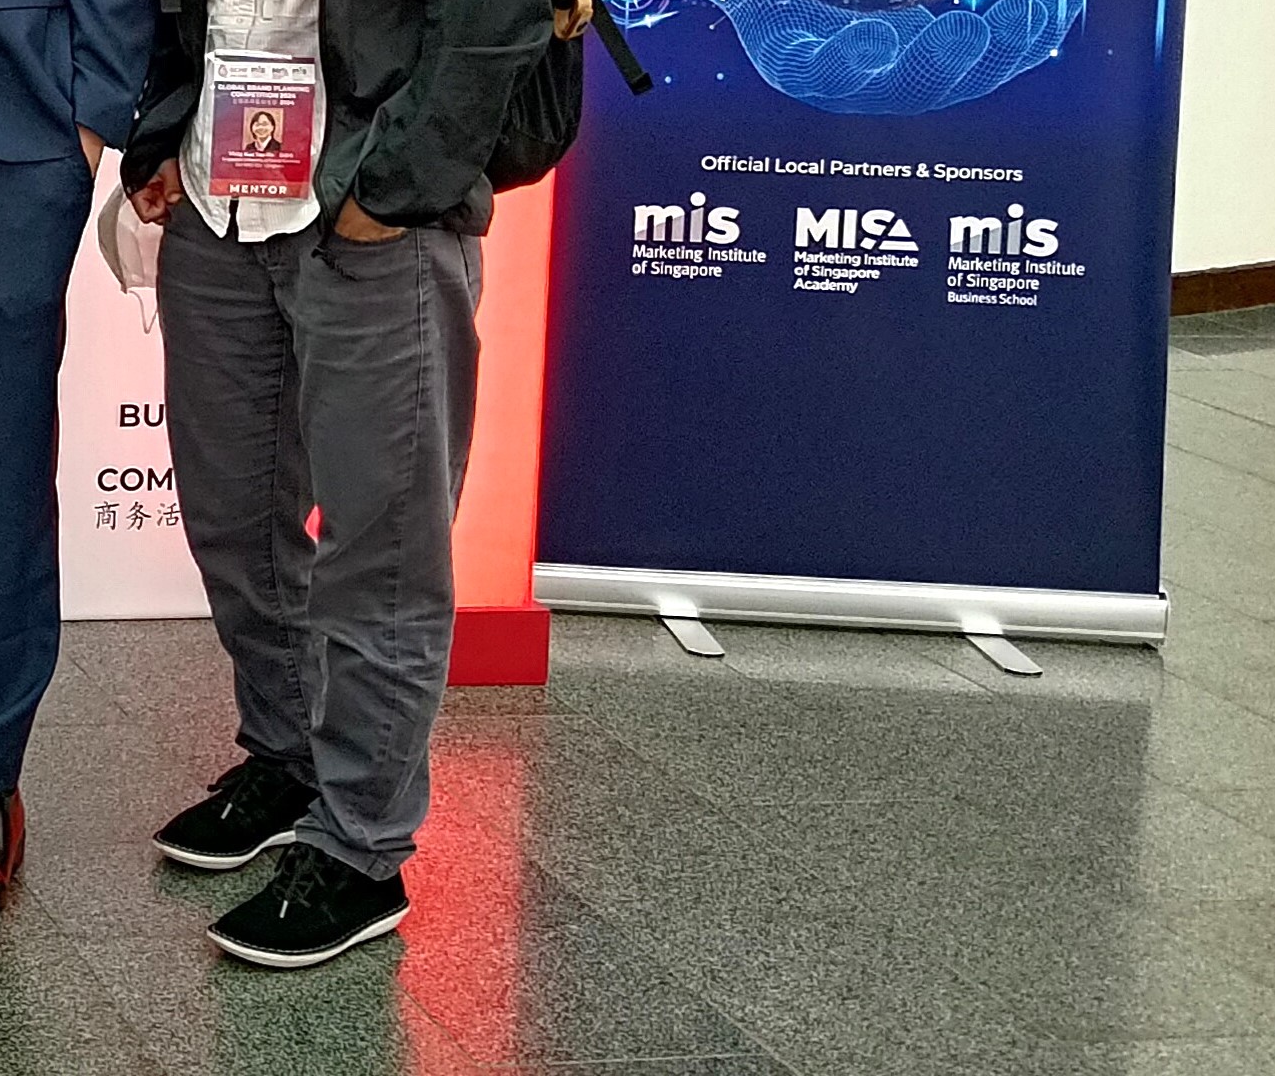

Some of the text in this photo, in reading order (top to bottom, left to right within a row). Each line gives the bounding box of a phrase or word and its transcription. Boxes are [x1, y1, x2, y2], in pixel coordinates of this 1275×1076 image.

[701, 154, 1023, 181] Official Local Partners & Sponsors
[230, 184, 287, 194] MENTOR
[634, 191, 740, 245] mis
[949, 203, 1059, 257] mis
[632, 244, 767, 264] Marketing Institute
[794, 250, 919, 268] Marketing Institute
[632, 260, 723, 280] of Singapore
[794, 264, 880, 282] of Singapore
[948, 257, 1085, 276] Marketing Institute
[794, 277, 858, 294] Academy
[948, 272, 1040, 293] of Singapore
[948, 291, 1038, 307] Business School
